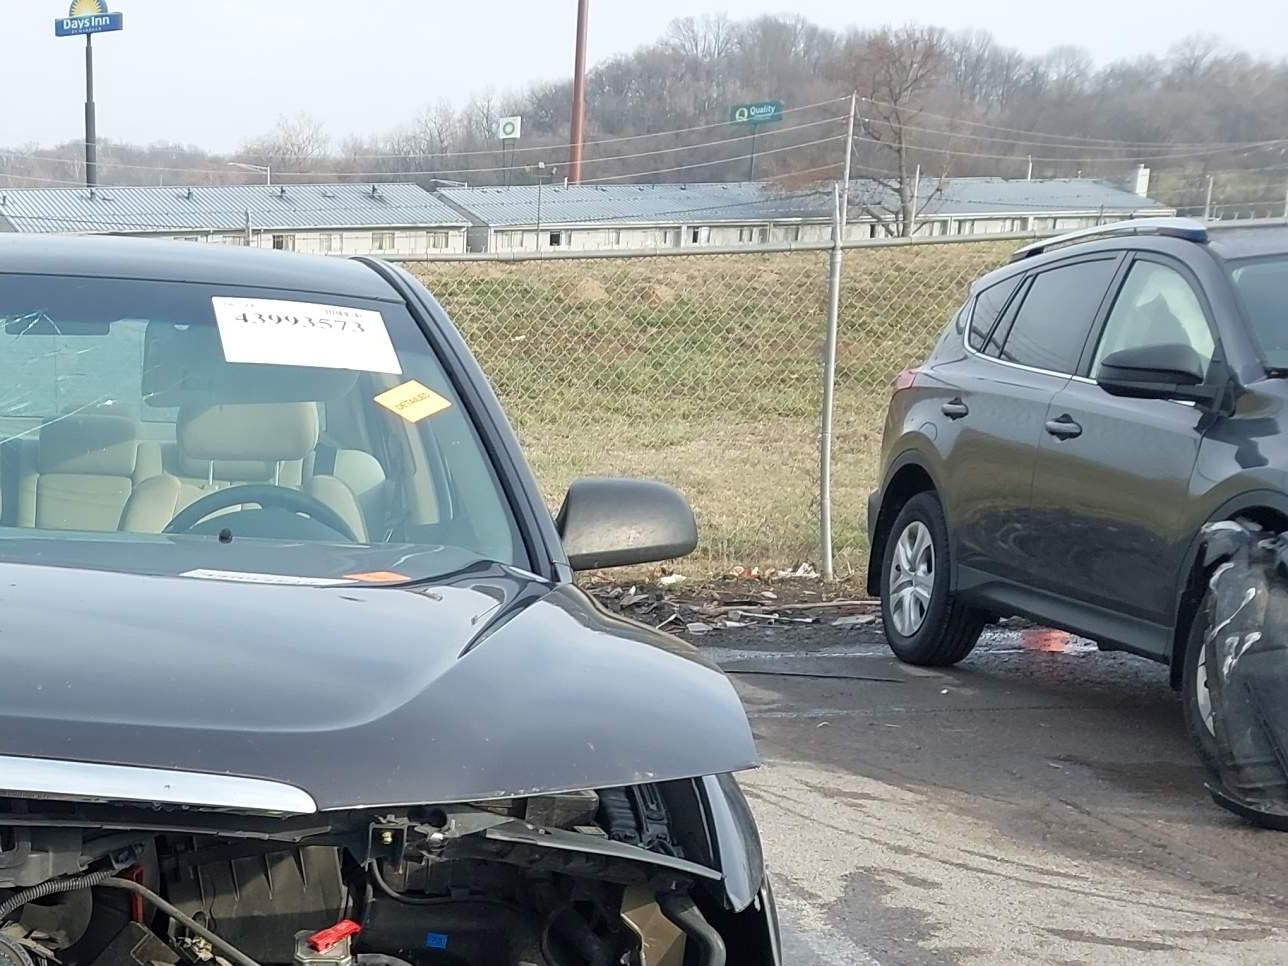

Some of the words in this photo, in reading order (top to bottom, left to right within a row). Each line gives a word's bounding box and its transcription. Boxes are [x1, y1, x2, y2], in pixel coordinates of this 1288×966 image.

[63, 18, 90, 29] Days
[91, 16, 110, 27] Inn
[749, 104, 776, 115] Quality
[234, 311, 366, 333] 43993573
